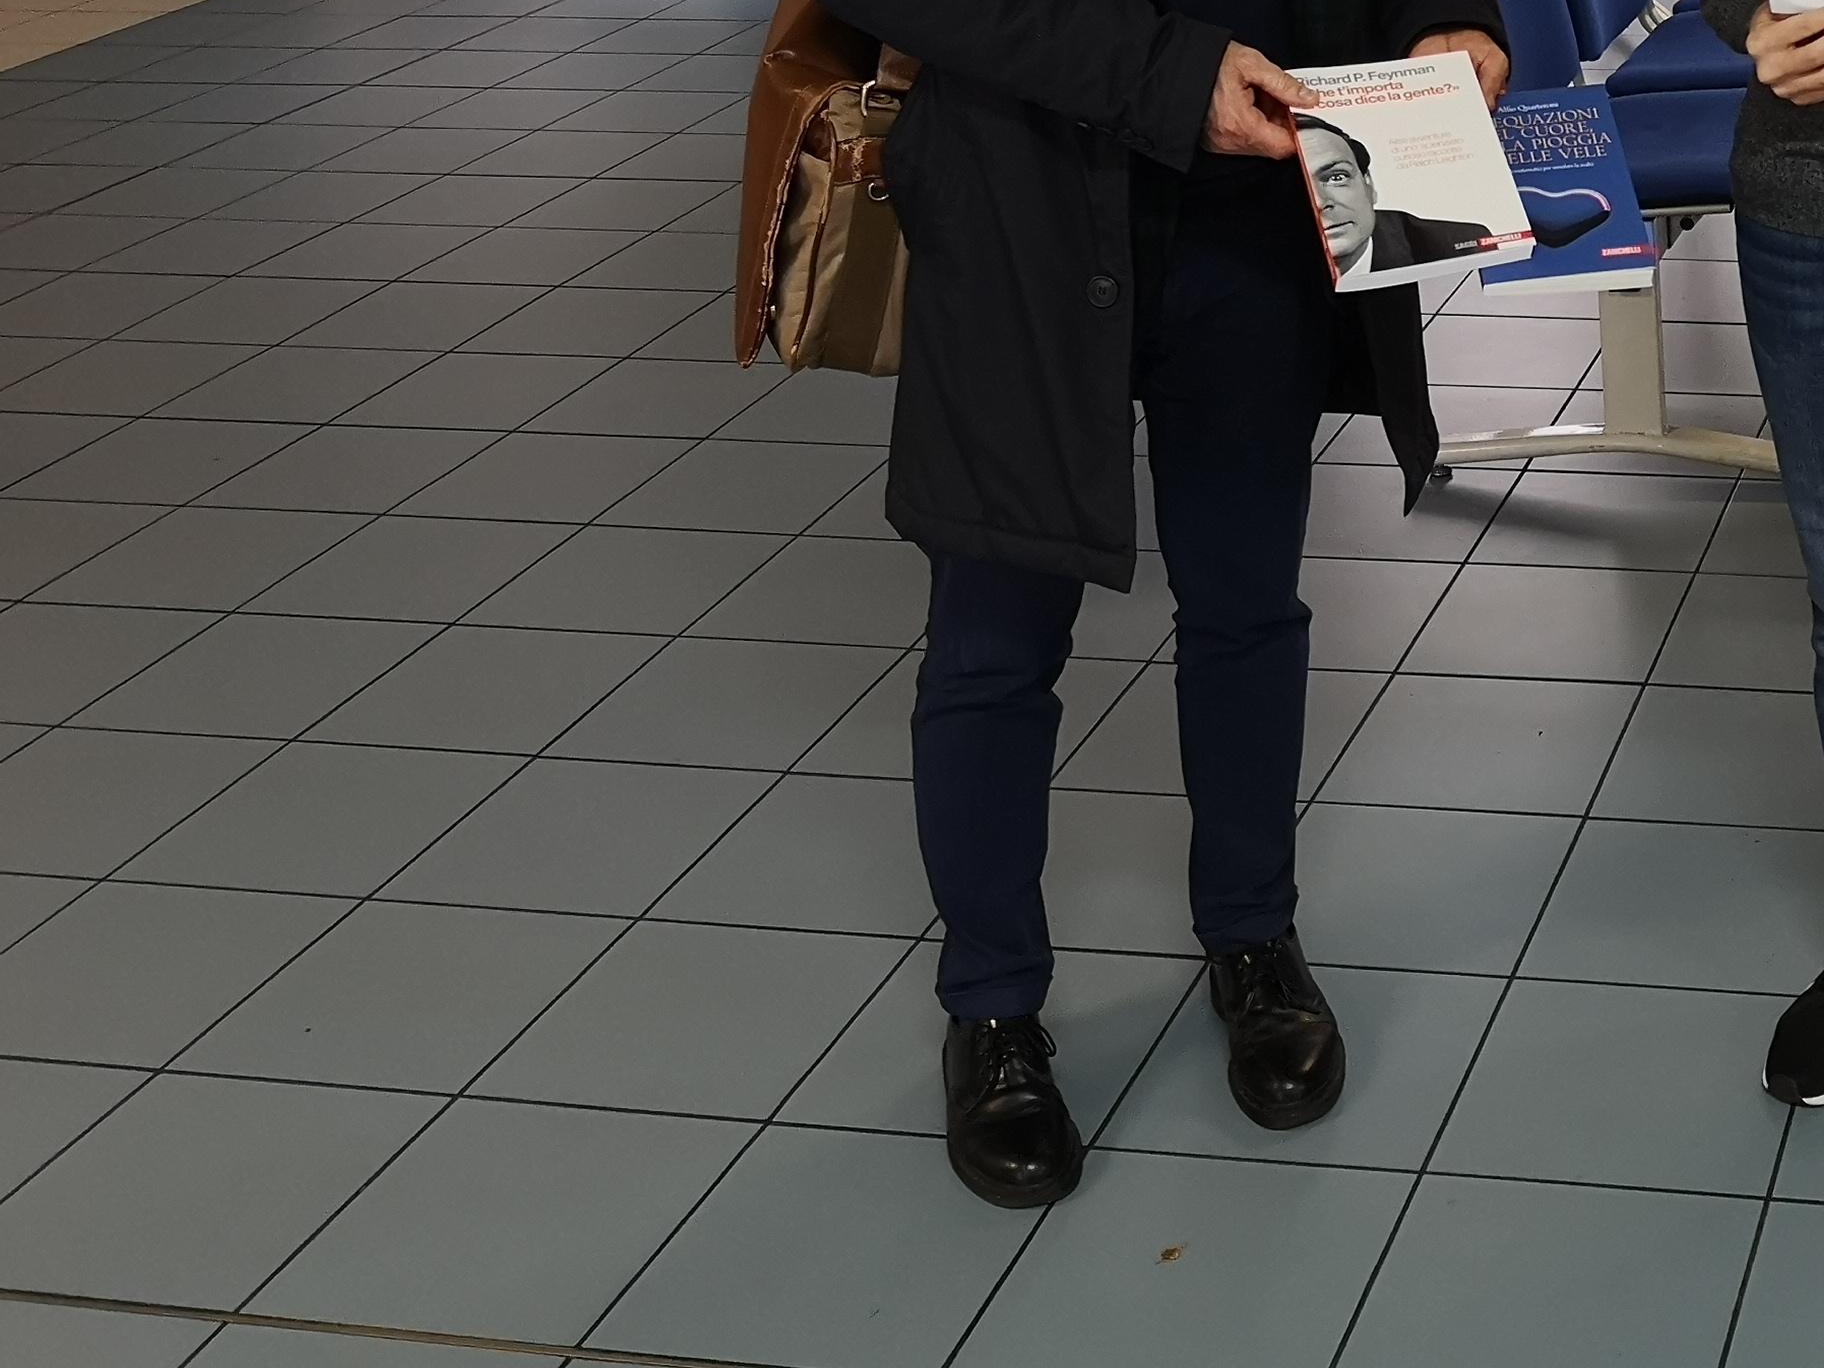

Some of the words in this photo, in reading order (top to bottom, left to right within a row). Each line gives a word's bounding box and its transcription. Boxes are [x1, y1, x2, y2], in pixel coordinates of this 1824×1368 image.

[1354, 72, 1366, 83] P.
[1368, 64, 1436, 83] Feynman
[1337, 80, 1404, 96] t'importa
[1317, 98, 1353, 109] cosa
[1355, 94, 1386, 105] dice
[1388, 89, 1402, 101] la
[1492, 107, 1600, 129] EQUAZIONI
[1521, 120, 1594, 138] CUORE,
[1532, 132, 1612, 150] PIOGGIA
[1508, 149, 1553, 165] ELLE
[1558, 144, 1608, 159] VELE
